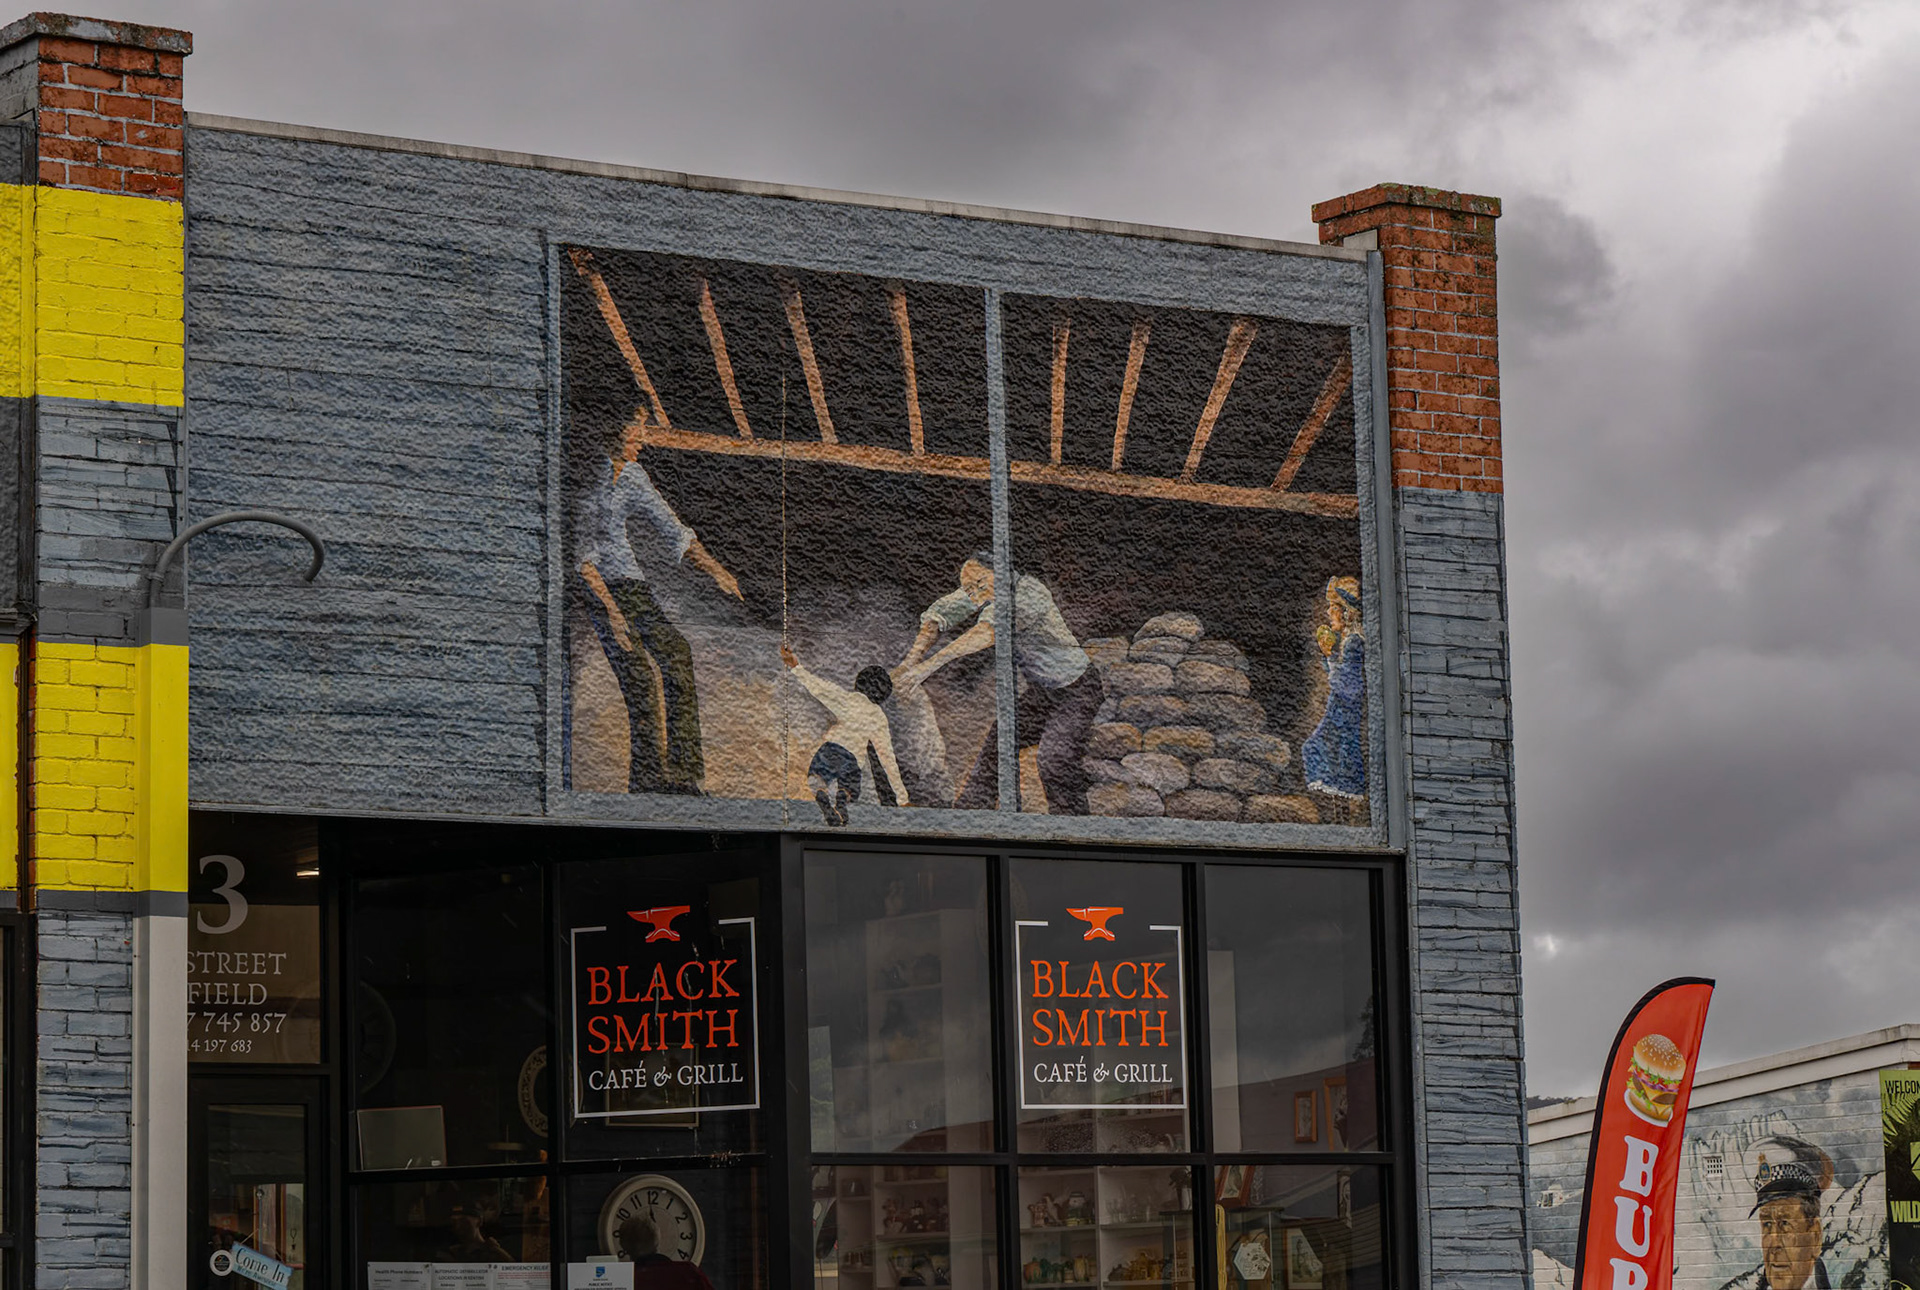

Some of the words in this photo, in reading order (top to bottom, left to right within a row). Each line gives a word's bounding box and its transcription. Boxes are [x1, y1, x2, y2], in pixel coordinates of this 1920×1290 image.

[197, 854, 248, 934] 3
[187, 951, 286, 975] STREET
[587, 959, 740, 1005] BLACK
[1031, 960, 1169, 999] BLACK
[203, 1012, 243, 1033] 745
[250, 1012, 287, 1033] 857
[588, 1009, 739, 1054] SMITH
[1032, 1008, 1169, 1047] SMITH
[204, 1039, 227, 1052] 197
[231, 1039, 252, 1054] 683
[589, 1060, 647, 1091] CAFÉ
[653, 1066, 672, 1087] &
[677, 1063, 744, 1086] GRILL
[1034, 1056, 1087, 1084] CAFÉ
[1093, 1062, 1110, 1083] &
[1114, 1062, 1173, 1084] GRILL
[630, 1195, 642, 1209] 11
[647, 1191, 659, 1205] 12
[616, 1208, 631, 1221] 10
[675, 1212, 689, 1224] 2
[1890, 1200, 1920, 1223] WILD
[680, 1232, 693, 1241] 3
[235, 1247, 268, 1275] Come
[272, 1264, 285, 1283] In
